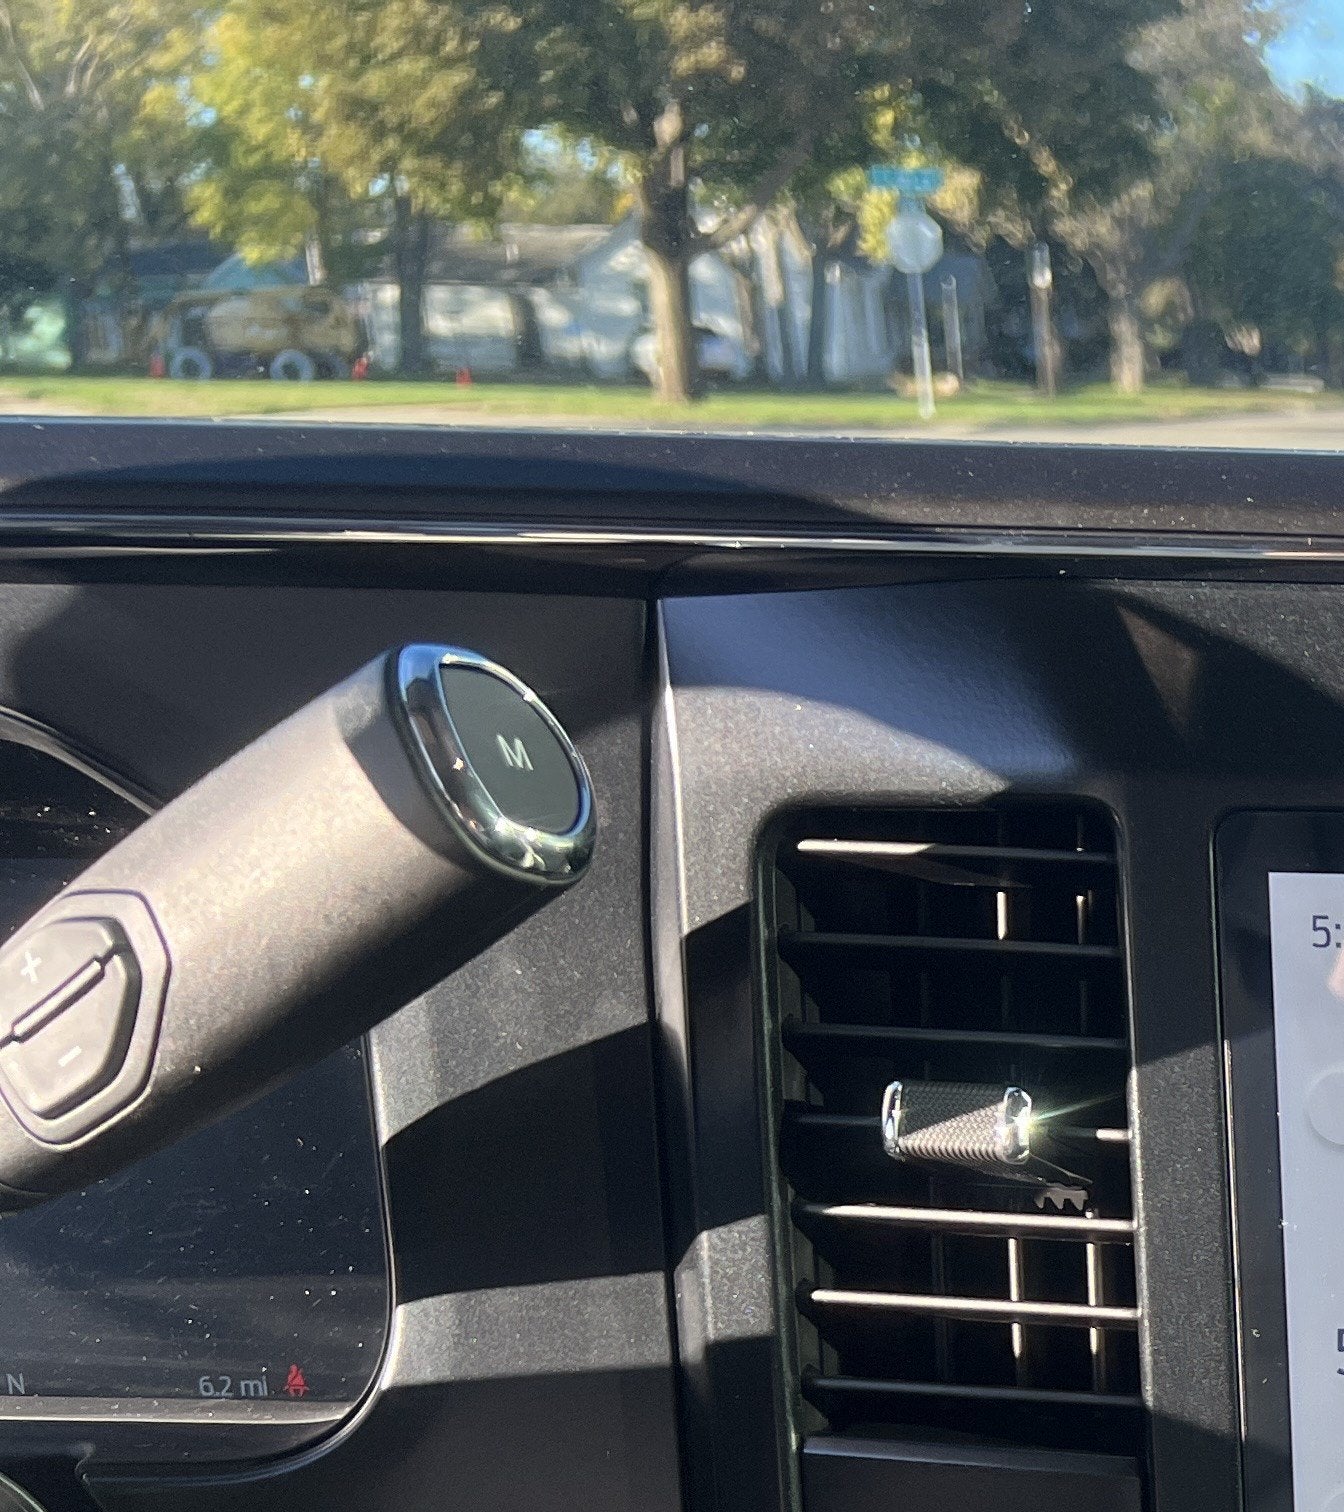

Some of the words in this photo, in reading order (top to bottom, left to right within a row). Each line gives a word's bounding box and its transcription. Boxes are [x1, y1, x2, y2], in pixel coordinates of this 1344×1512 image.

[496, 734, 534, 771] M
[6, 1373, 25, 1395] N
[199, 1375, 233, 1397] 6.2
[240, 1375, 268, 1397] mi
